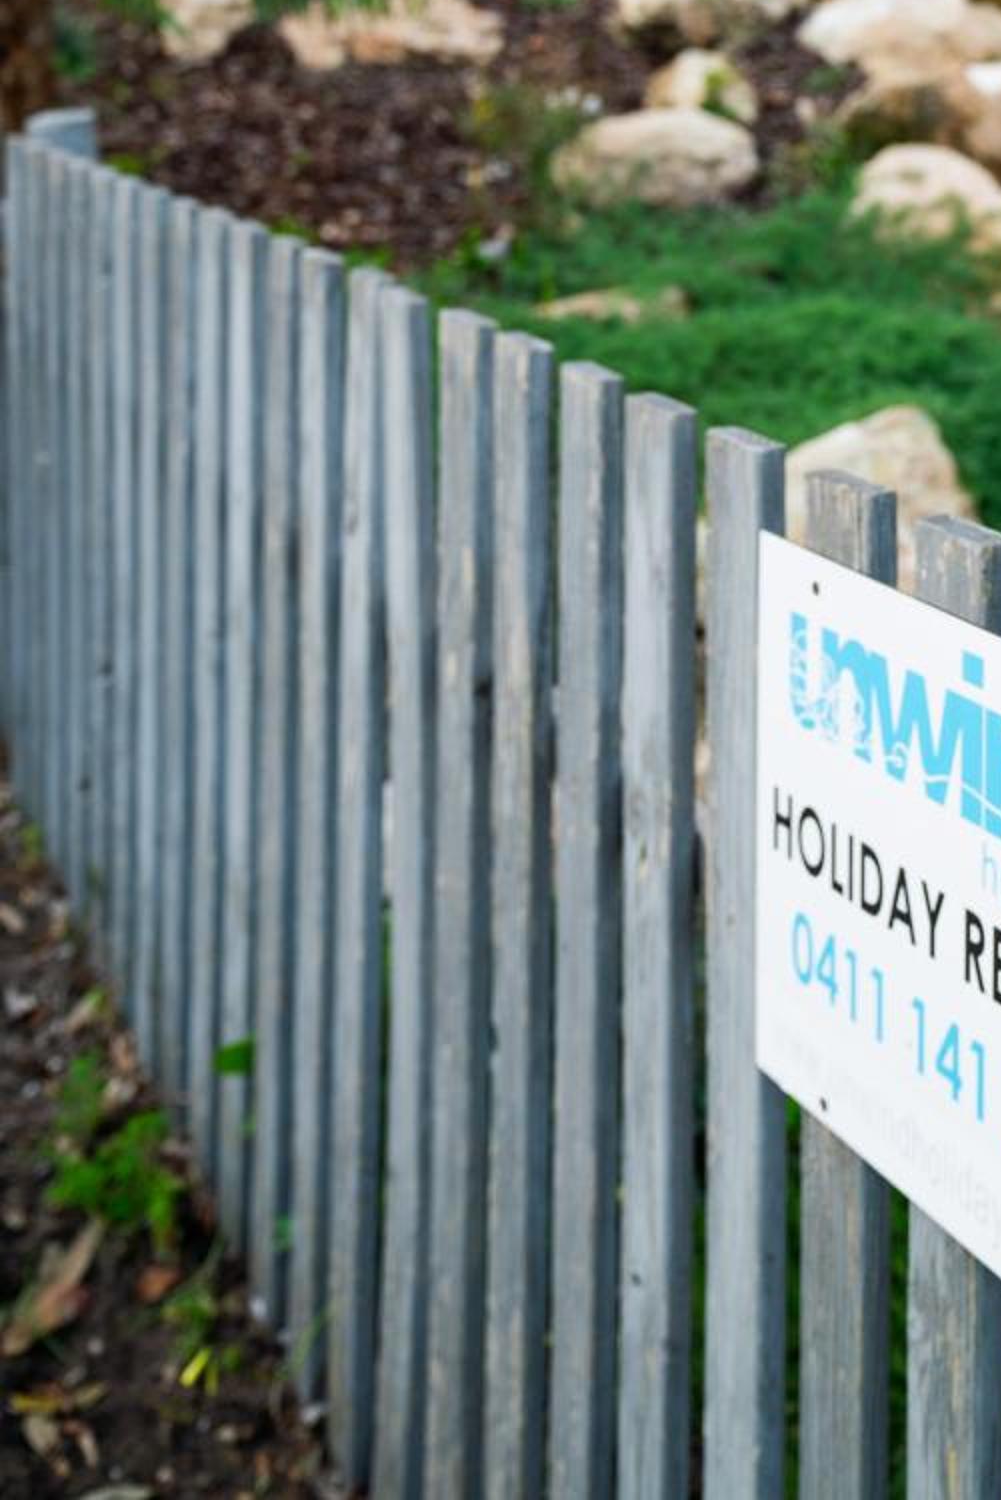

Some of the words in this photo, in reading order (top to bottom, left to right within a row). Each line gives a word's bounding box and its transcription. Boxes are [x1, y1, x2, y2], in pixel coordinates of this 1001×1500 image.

[772, 784, 945, 961] HOLIDAY
[790, 911, 886, 1043] 0411
[911, 996, 986, 1123] 141
